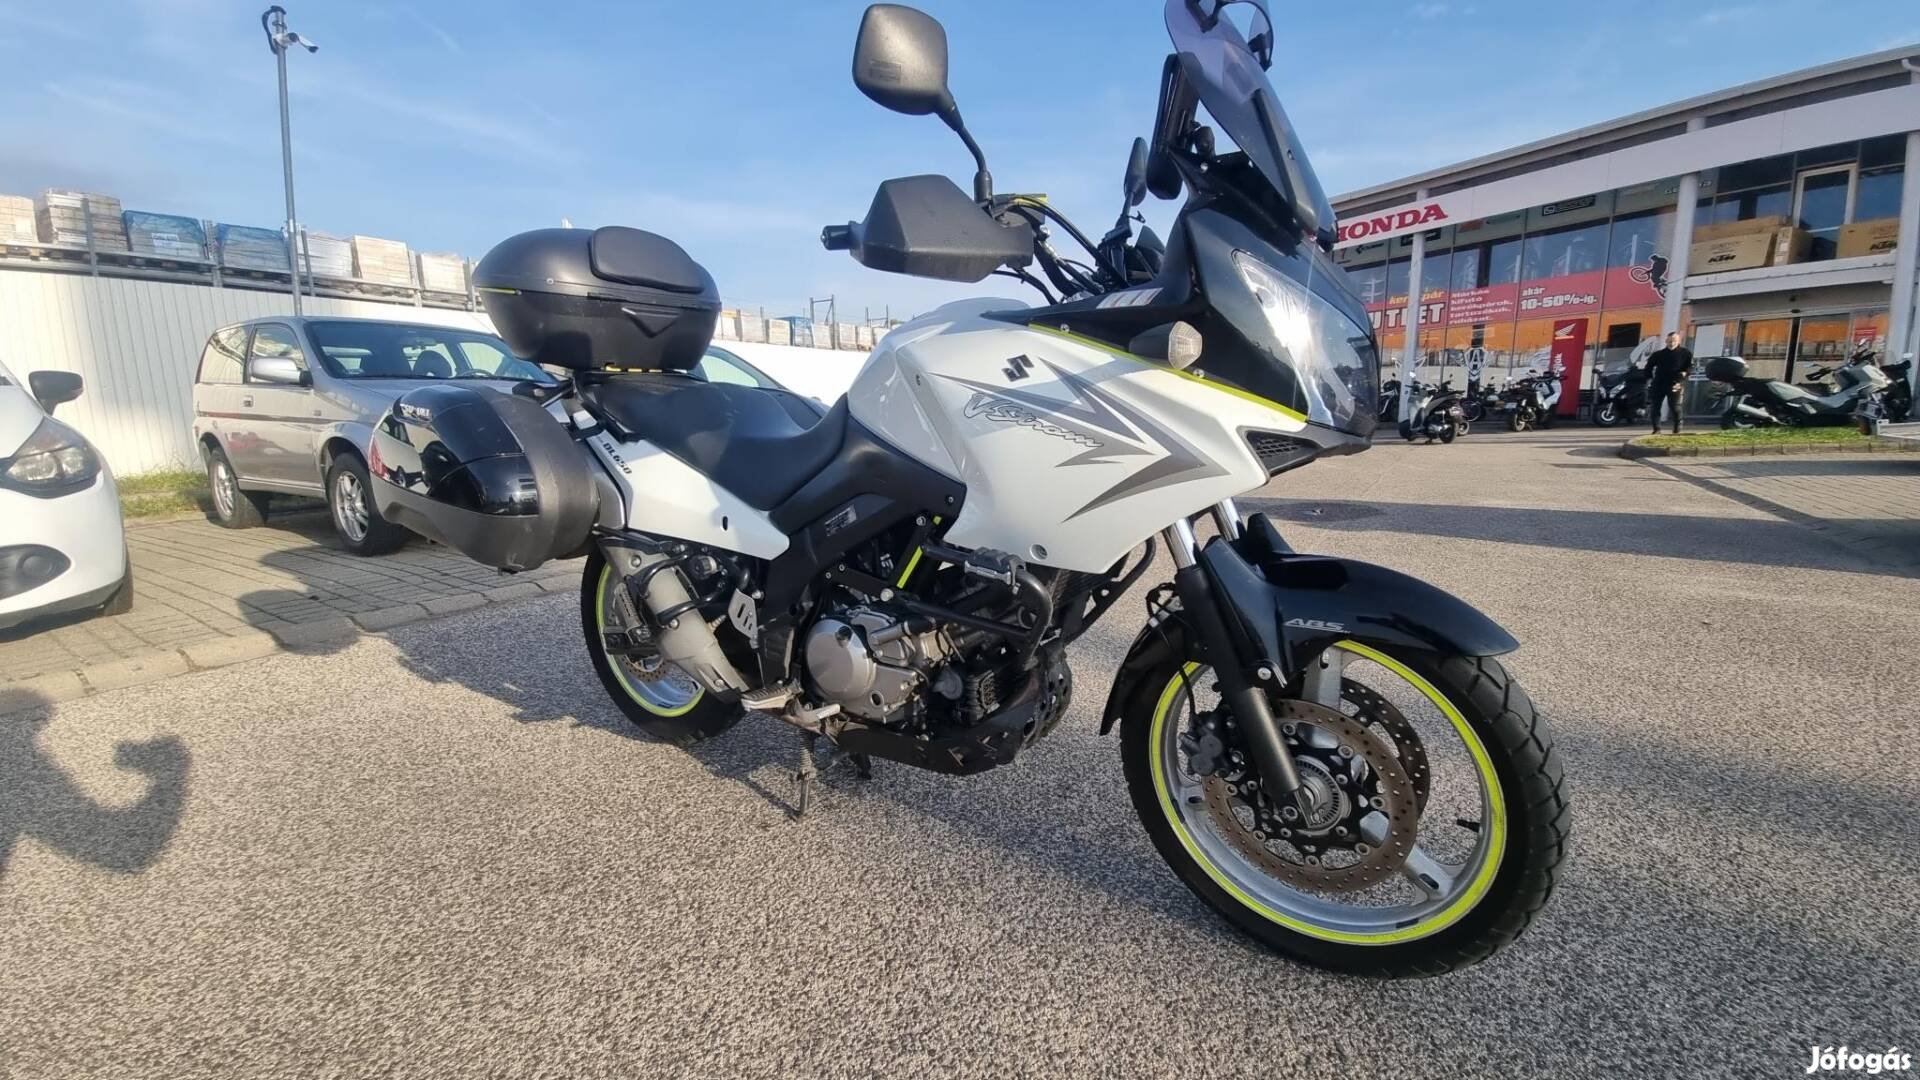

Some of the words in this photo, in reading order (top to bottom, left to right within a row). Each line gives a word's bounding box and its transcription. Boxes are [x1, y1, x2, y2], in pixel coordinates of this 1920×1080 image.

[1389, 290, 1445, 304] kerpár
[1368, 303, 1445, 329] UTLET
[1284, 618, 1345, 632] ABS
